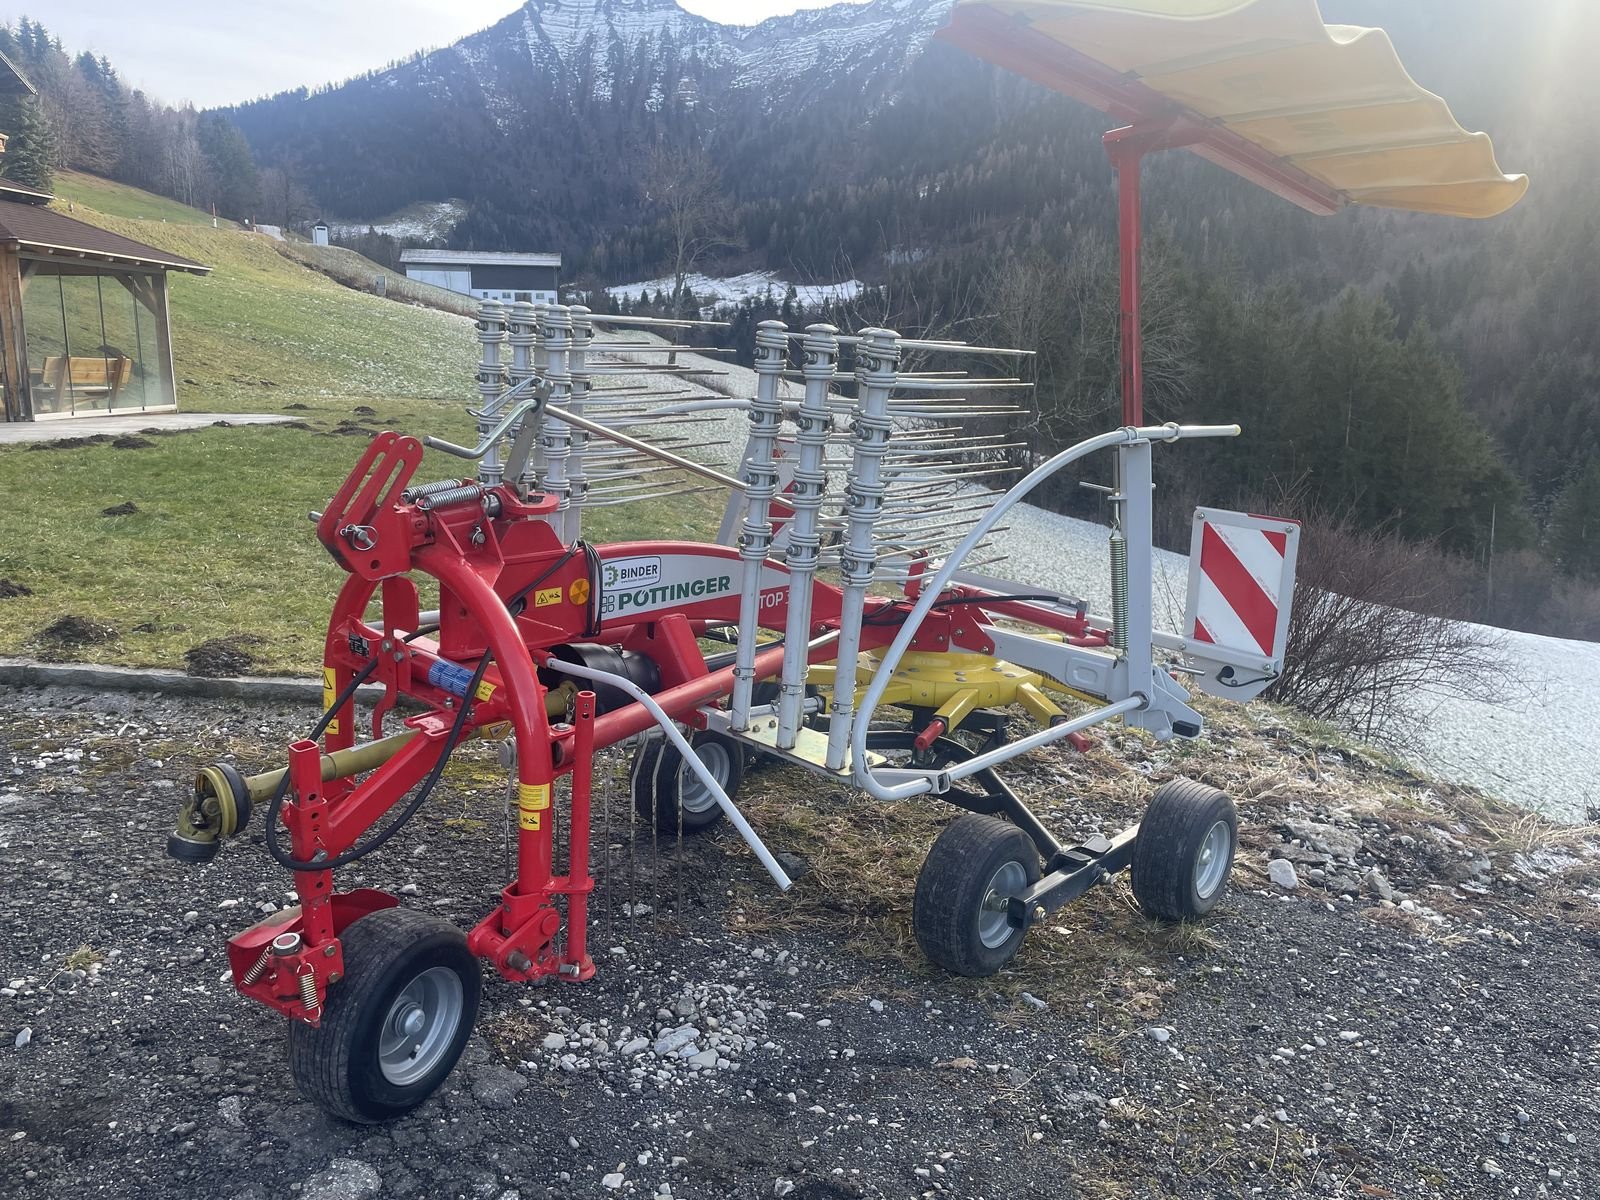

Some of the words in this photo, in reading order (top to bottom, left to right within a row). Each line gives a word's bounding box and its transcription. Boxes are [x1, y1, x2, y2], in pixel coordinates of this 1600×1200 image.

[620, 564, 658, 579] BINDER
[618, 575, 731, 610] PÖTTINGER
[759, 591, 784, 609] TOP
